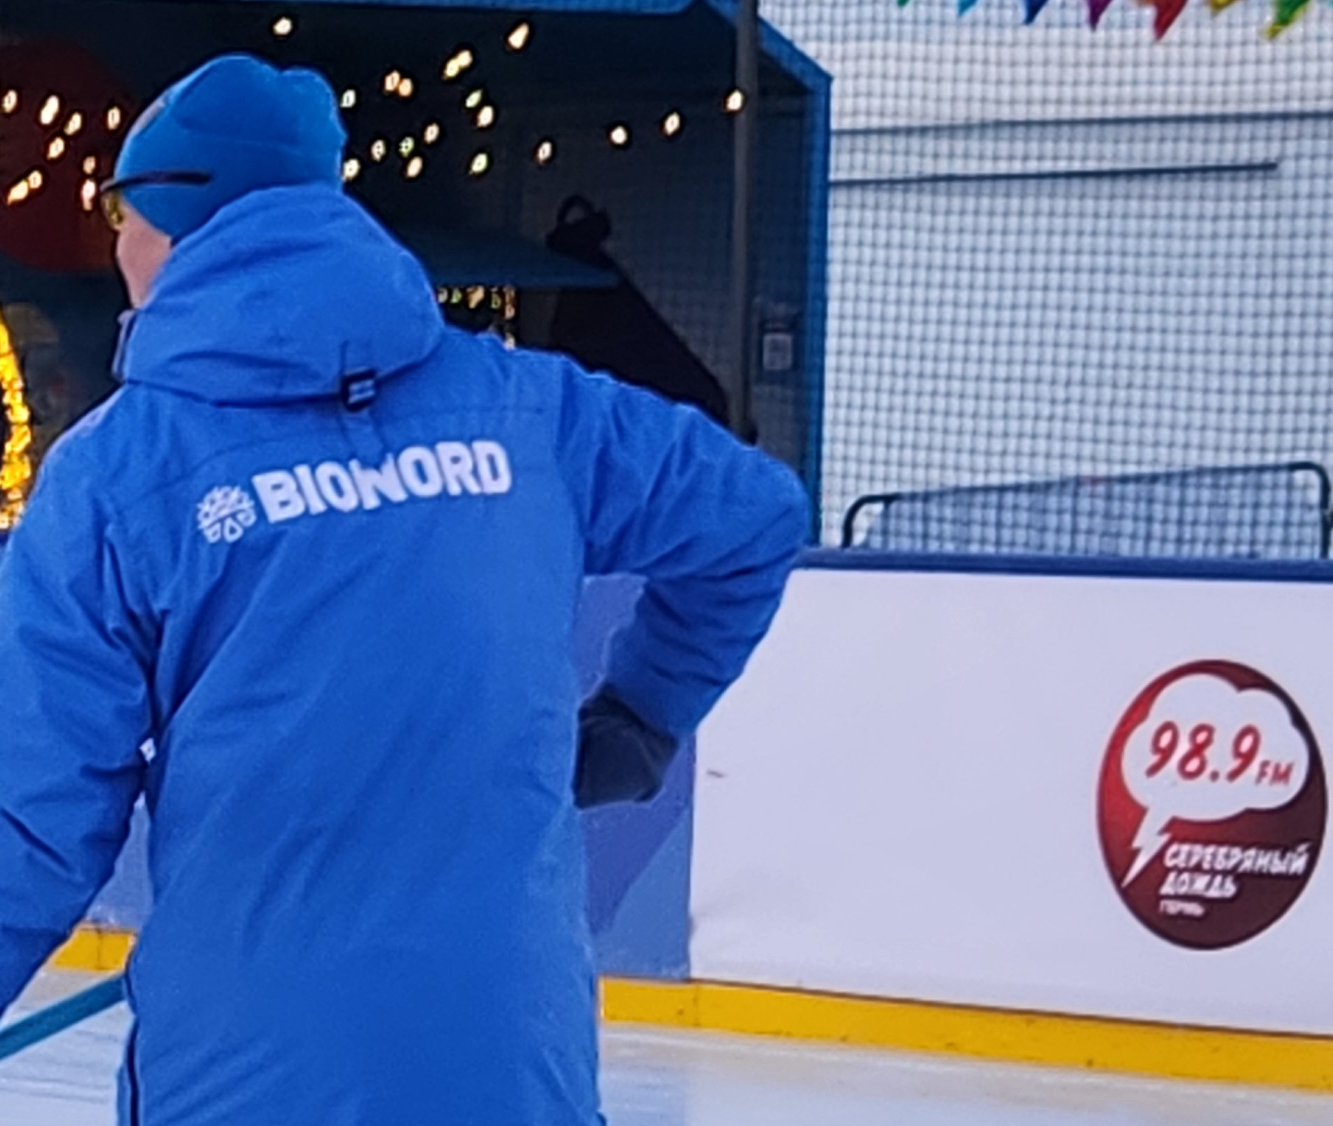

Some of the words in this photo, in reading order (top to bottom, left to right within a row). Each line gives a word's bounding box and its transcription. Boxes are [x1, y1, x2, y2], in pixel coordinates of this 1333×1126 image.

[251, 440, 512, 524] BIONORD
[1145, 720, 1261, 783] 98.9
[1255, 760, 1295, 786] FM
[1163, 842, 1312, 876] СЕРЕБРЯНЫЙ
[1159, 870, 1238, 899] ДОЖДЬ
